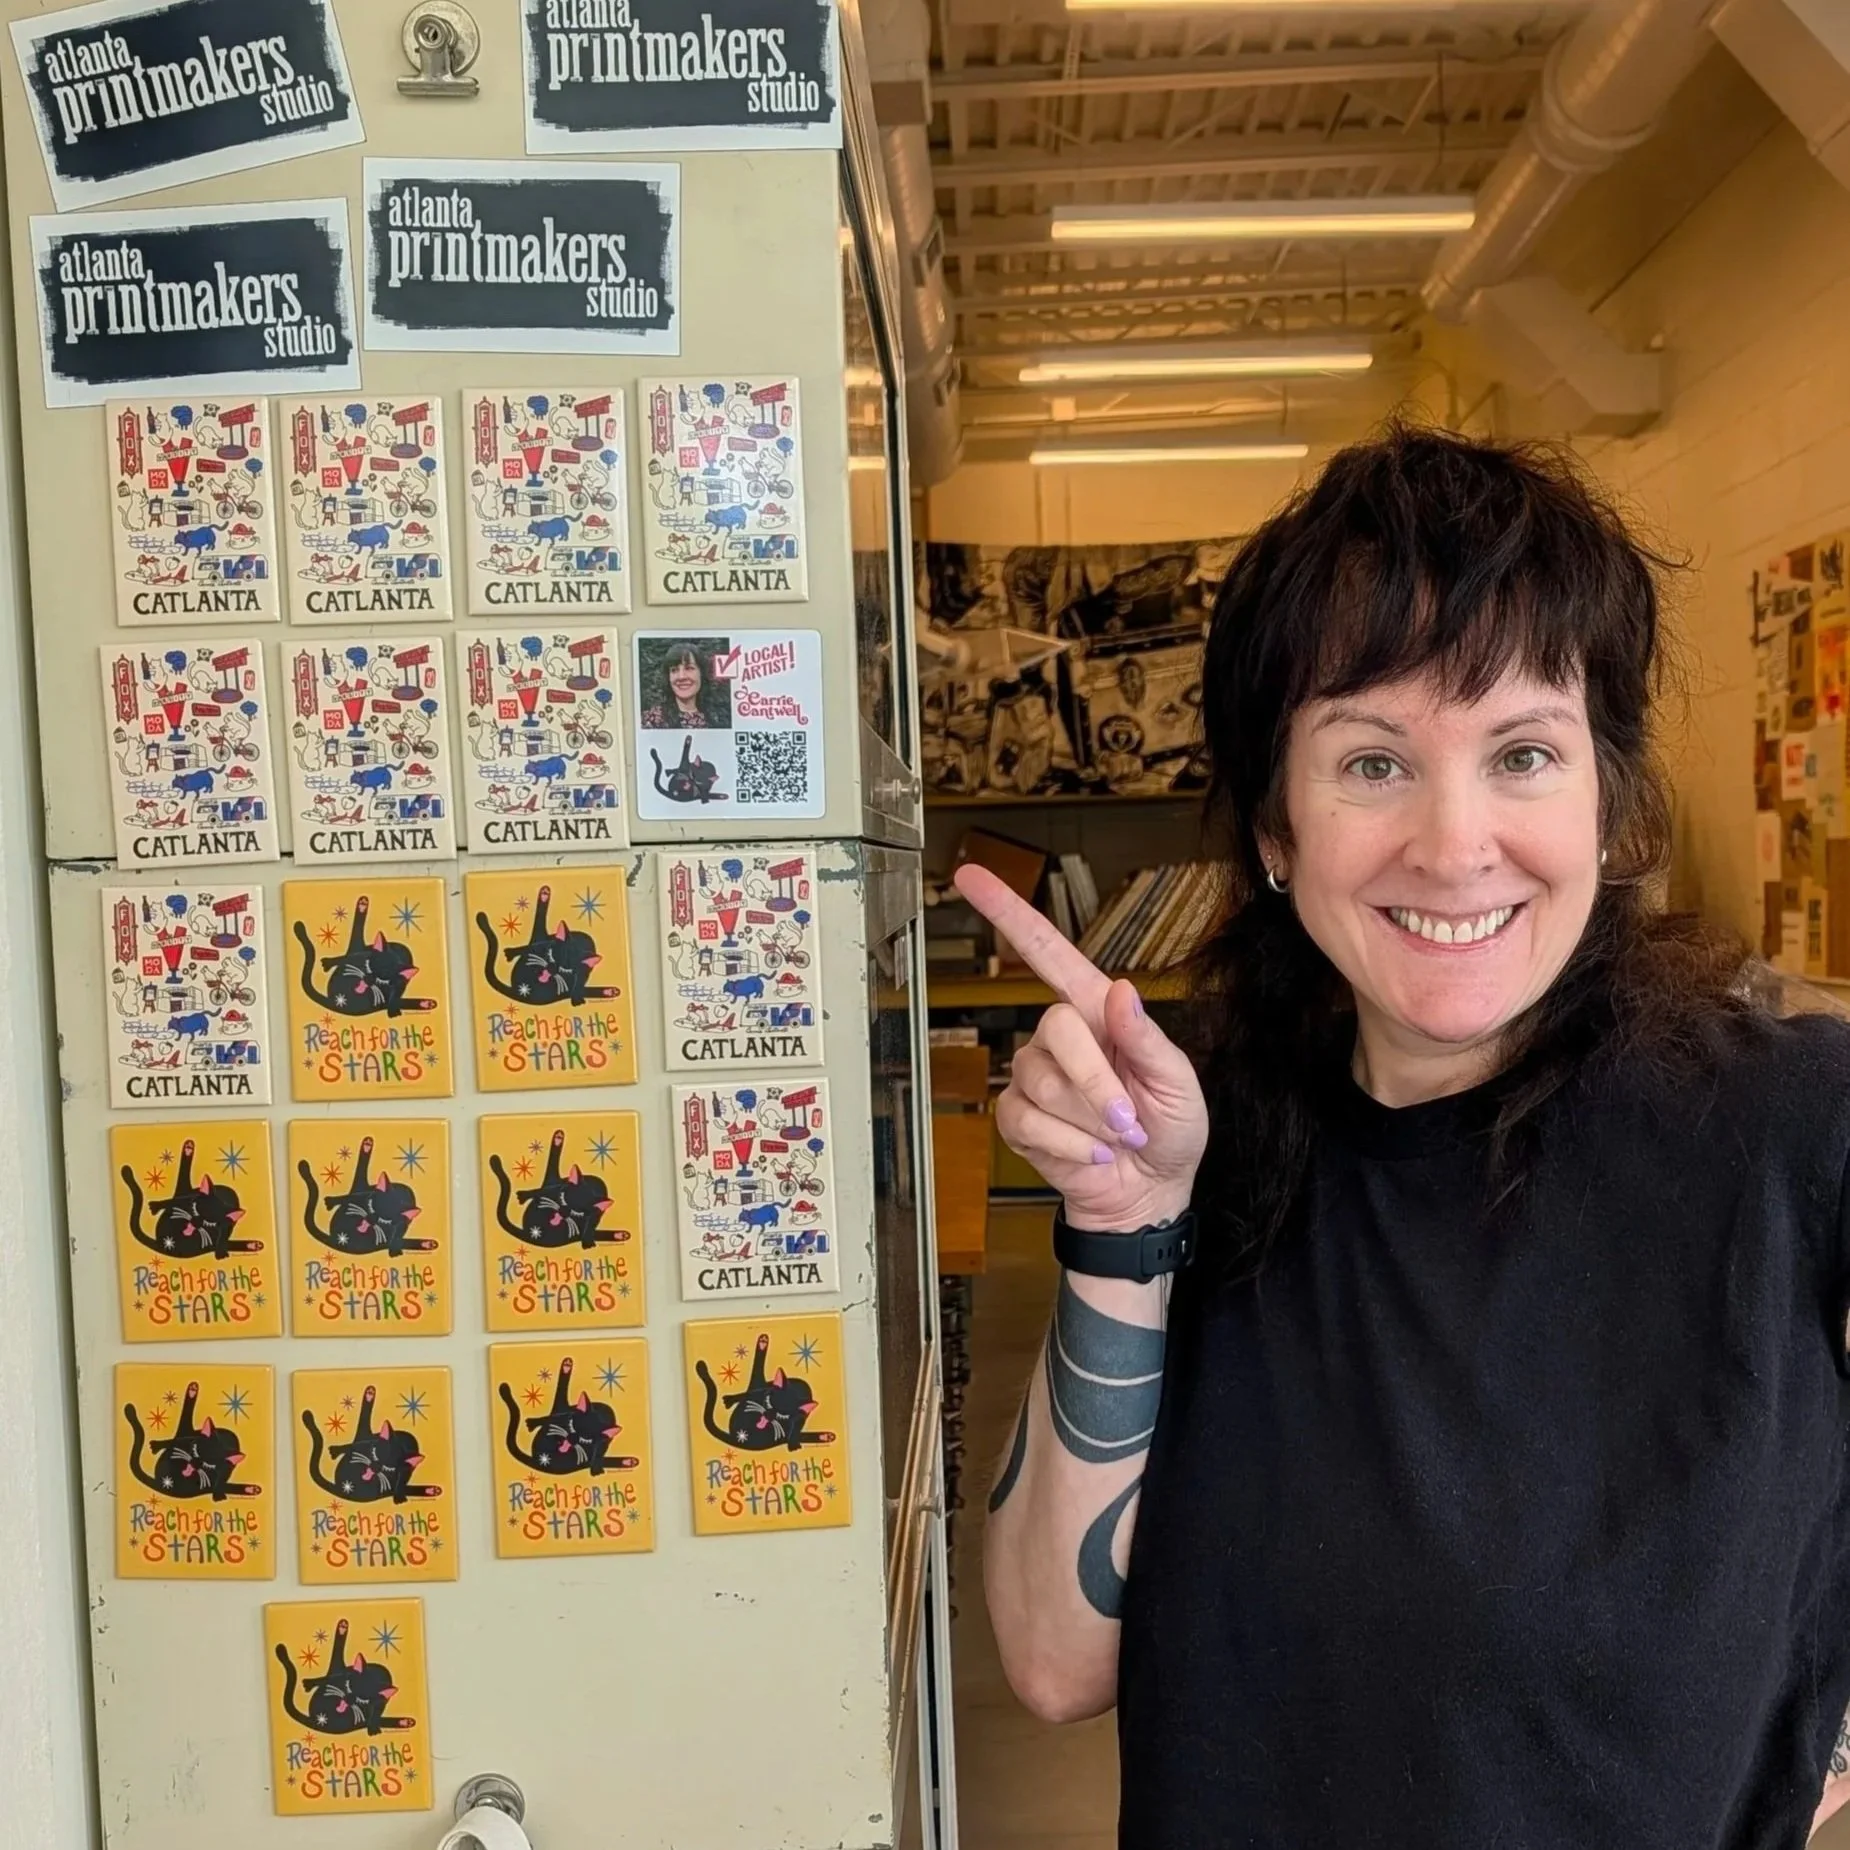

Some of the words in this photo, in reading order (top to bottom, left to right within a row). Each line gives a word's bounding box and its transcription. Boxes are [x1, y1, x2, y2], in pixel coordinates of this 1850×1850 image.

[546, 0, 632, 28] atlanta
[44, 30, 134, 84] atlanta
[547, 13, 788, 91] printmakers
[53, 35, 296, 145] printmakers
[259, 76, 335, 126] studio
[747, 71, 820, 113] studio
[388, 186, 475, 229] atlanta
[58, 239, 146, 283] atlanta
[388, 217, 627, 287] printmakers
[61, 261, 303, 344] printmakers
[585, 277, 659, 319] studio
[264, 315, 337, 359] studio
[480, 409, 490, 456] FOX
[656, 397, 667, 445] FOX
[124, 420, 135, 467] FOX
[298, 418, 309, 466] FOX
[485, 581, 613, 604] CATLANTA
[663, 569, 791, 594] CATLANTA
[133, 589, 261, 615] CATLANTA
[306, 588, 434, 613] CATLANTA
[744, 643, 788, 666] LOCAL
[119, 667, 131, 714] FOX
[299, 662, 311, 708] FOX
[474, 651, 485, 698] FOX
[734, 685, 794, 706] Carrie
[737, 700, 809, 725] Cantwell
[133, 831, 261, 859] CATLANTA
[309, 828, 437, 854] CATLANTA
[484, 818, 611, 843] CATLANTA
[676, 873, 686, 919] FOX
[120, 908, 130, 955] FOX
[303, 1023, 365, 1054] Reach
[402, 1023, 435, 1051] the
[487, 1013, 549, 1044] Reach
[586, 1011, 619, 1039] the
[682, 1036, 807, 1061] CATLANTA
[126, 1074, 253, 1098] CATLANTA
[690, 1105, 701, 1150] FOX
[132, 1265, 194, 1296] Reach
[230, 1265, 263, 1293] the
[304, 1260, 365, 1291] Reach
[402, 1263, 435, 1291] the
[498, 1255, 559, 1285] Reach
[596, 1255, 628, 1282] the
[698, 1263, 823, 1290] CATLANTA
[705, 1459, 766, 1490] Reach
[802, 1456, 834, 1483] the
[507, 1482, 568, 1512] Reach
[604, 1481, 637, 1509] the
[129, 1503, 189, 1533] Reach
[226, 1508, 258, 1536] the
[311, 1509, 371, 1539] Reach
[407, 1510, 440, 1537] the
[285, 1741, 346, 1771] Reach
[381, 1741, 414, 1768] the
